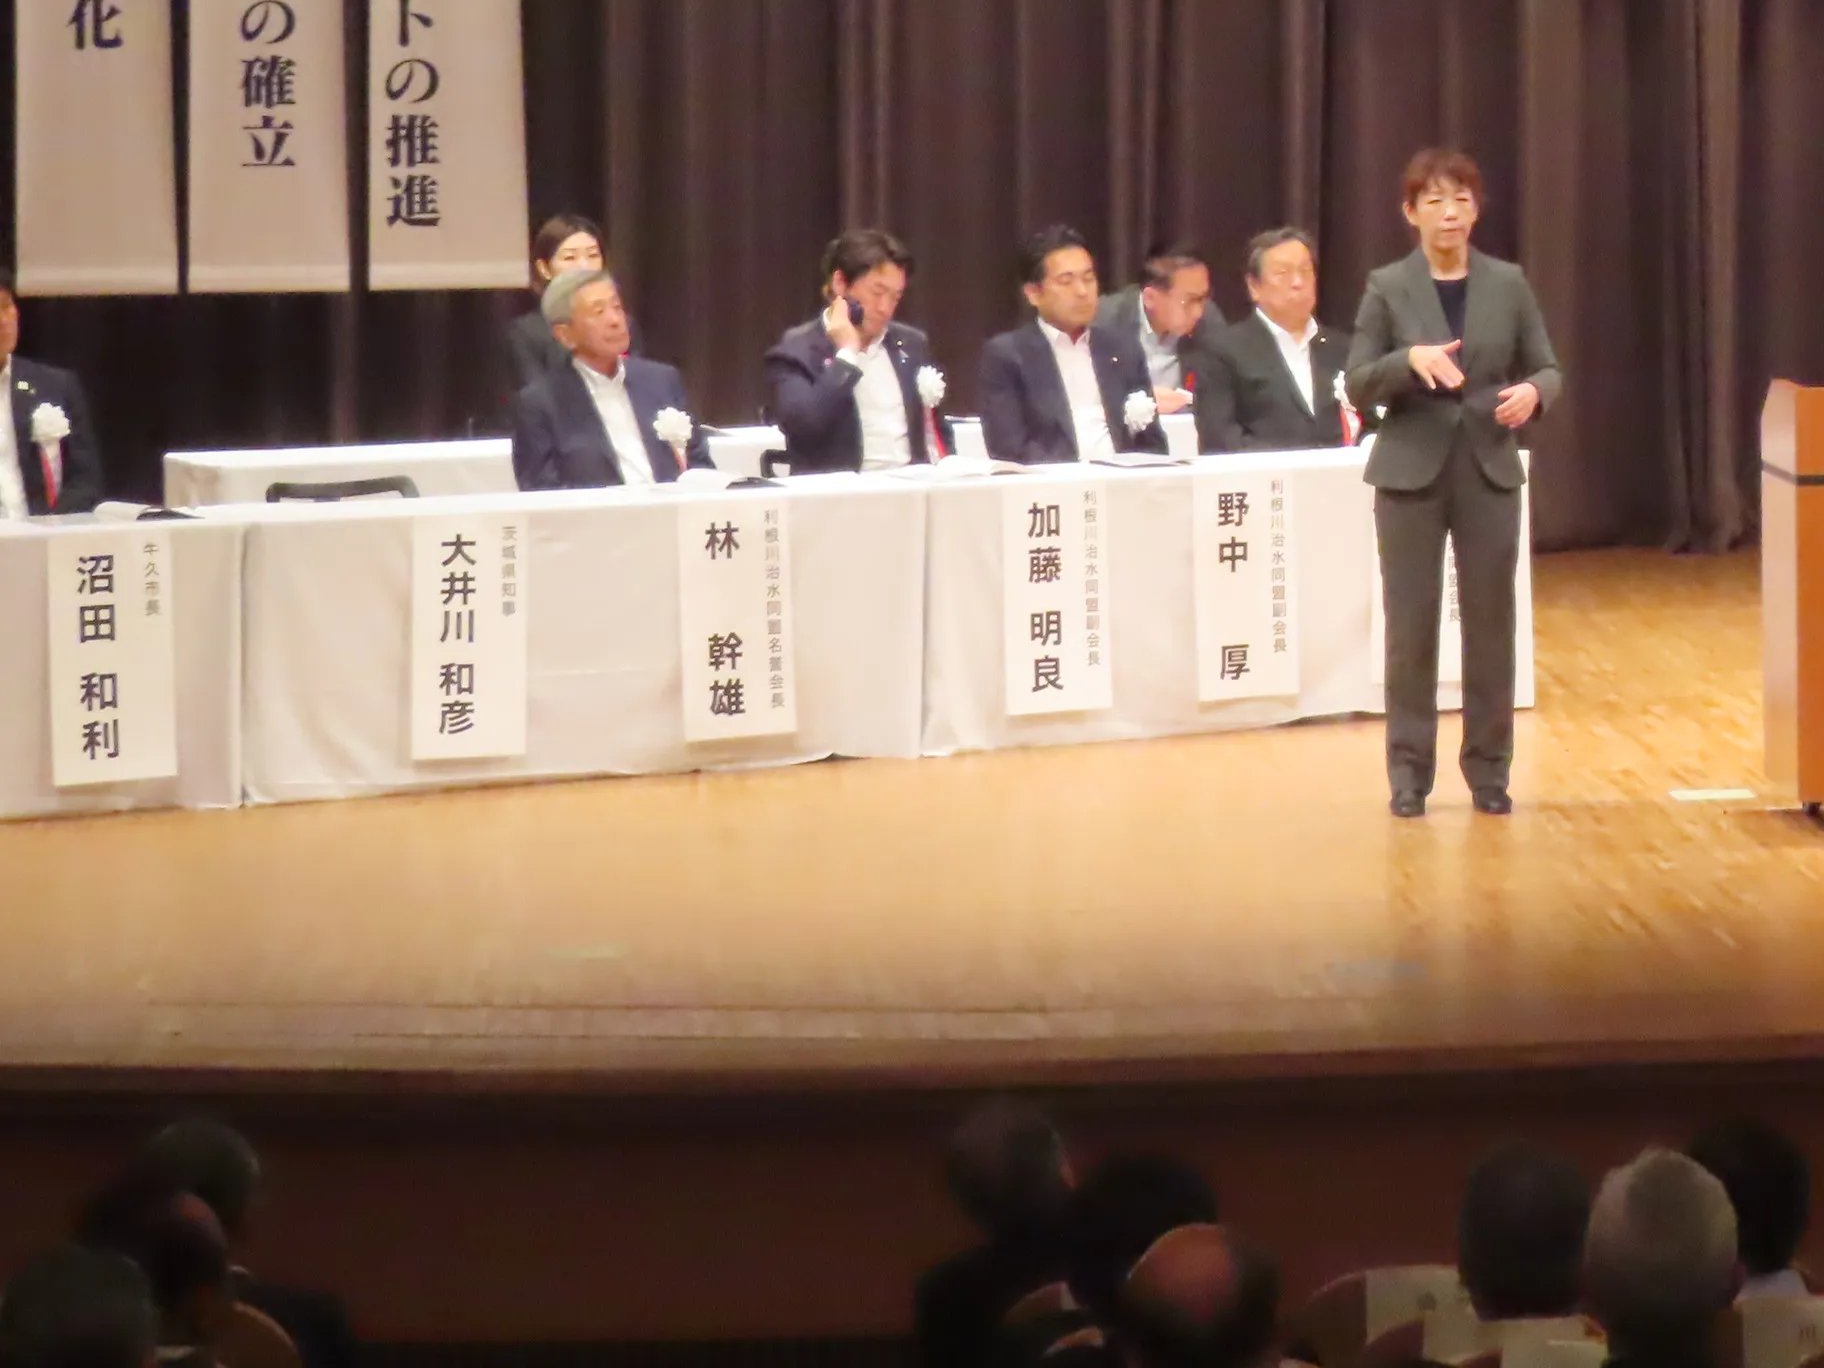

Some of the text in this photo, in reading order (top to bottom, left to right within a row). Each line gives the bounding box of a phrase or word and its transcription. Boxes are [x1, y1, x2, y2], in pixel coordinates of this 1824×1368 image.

[76, 554, 120, 761] 沼田 和利
[142, 542, 160, 617] 牛久市長
[438, 533, 477, 735] 大井川 和彦
[501, 525, 517, 617] 茨城県知事
[704, 520, 746, 717] 林 幹雄
[764, 509, 785, 709] 利根川治水同盟名誉会長
[1027, 502, 1064, 693] 加藤 明良
[1082, 490, 1101, 667] 利根川治水同盟副会長
[1217, 492, 1251, 681] 野中 厚
[1270, 480, 1288, 654] 利根川治水同盟副会長
